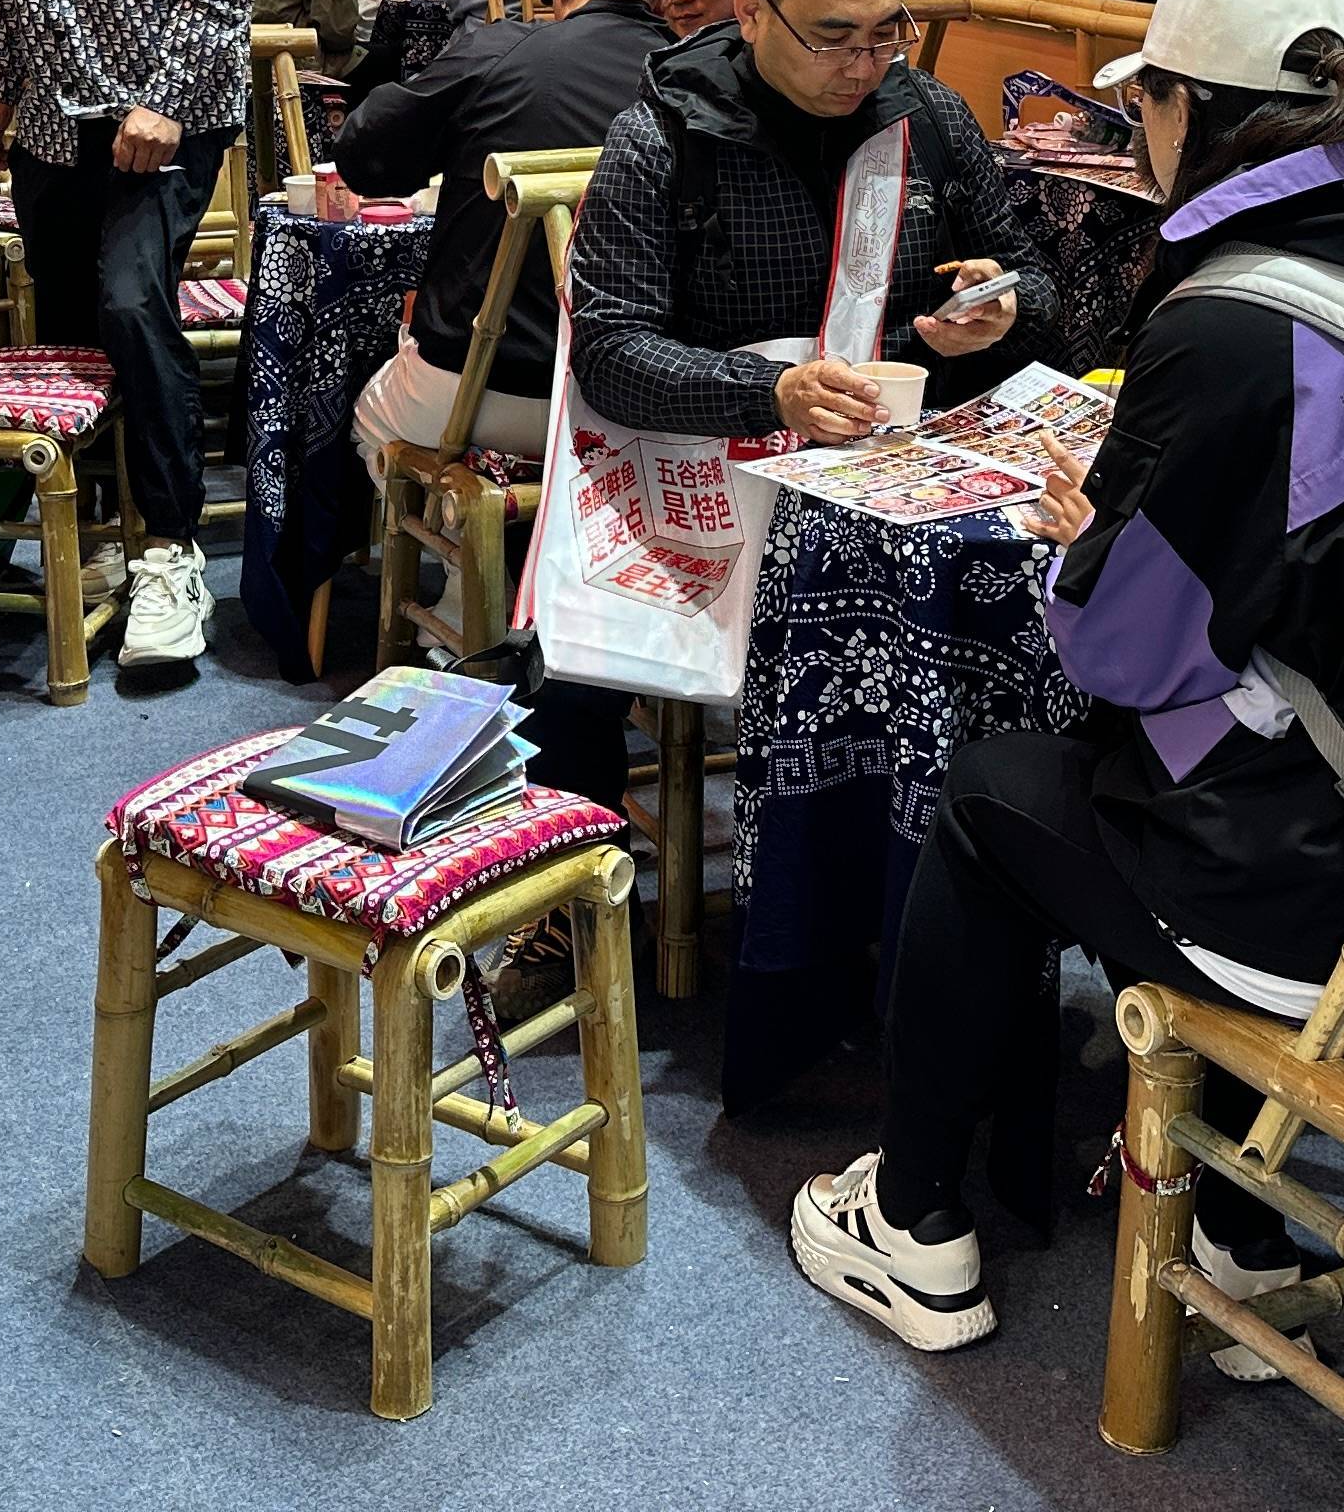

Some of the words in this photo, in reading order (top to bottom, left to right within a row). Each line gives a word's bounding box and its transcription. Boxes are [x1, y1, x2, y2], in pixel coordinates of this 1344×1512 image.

[577, 459, 638, 521] 搭配鲜鱼
[663, 489, 735, 533] 是特色
[585, 496, 647, 568] 是卖点
[608, 563, 711, 605] 是主打
[641, 546, 731, 583] 苗家酸汤
